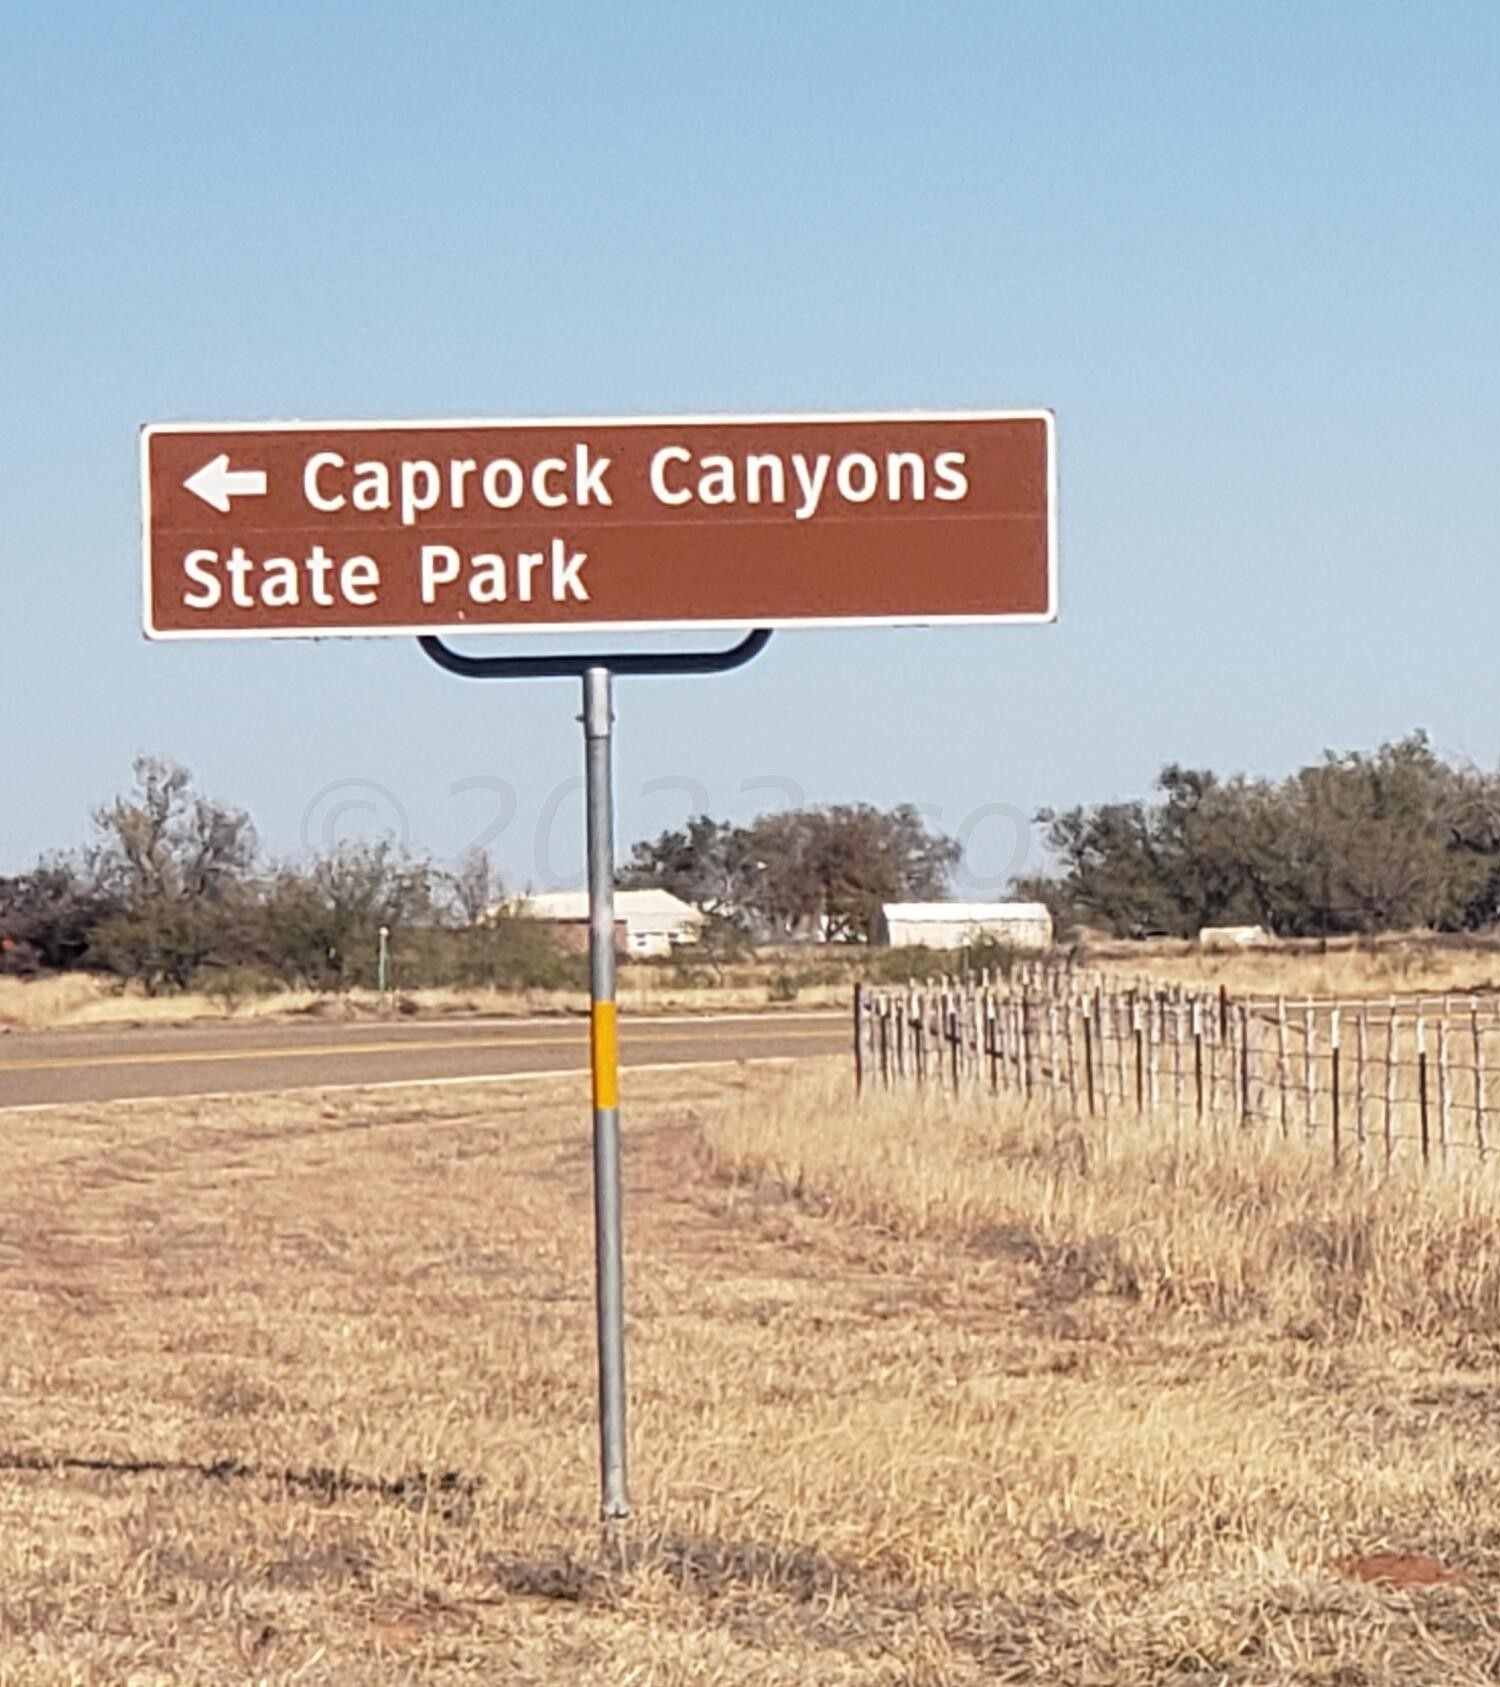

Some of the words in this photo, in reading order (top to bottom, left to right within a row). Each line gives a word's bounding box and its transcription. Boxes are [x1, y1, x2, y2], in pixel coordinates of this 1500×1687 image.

[302, 443, 613, 526] Caprock
[649, 445, 970, 520] Canyons
[182, 547, 381, 609] State
[420, 538, 590, 604] Park
